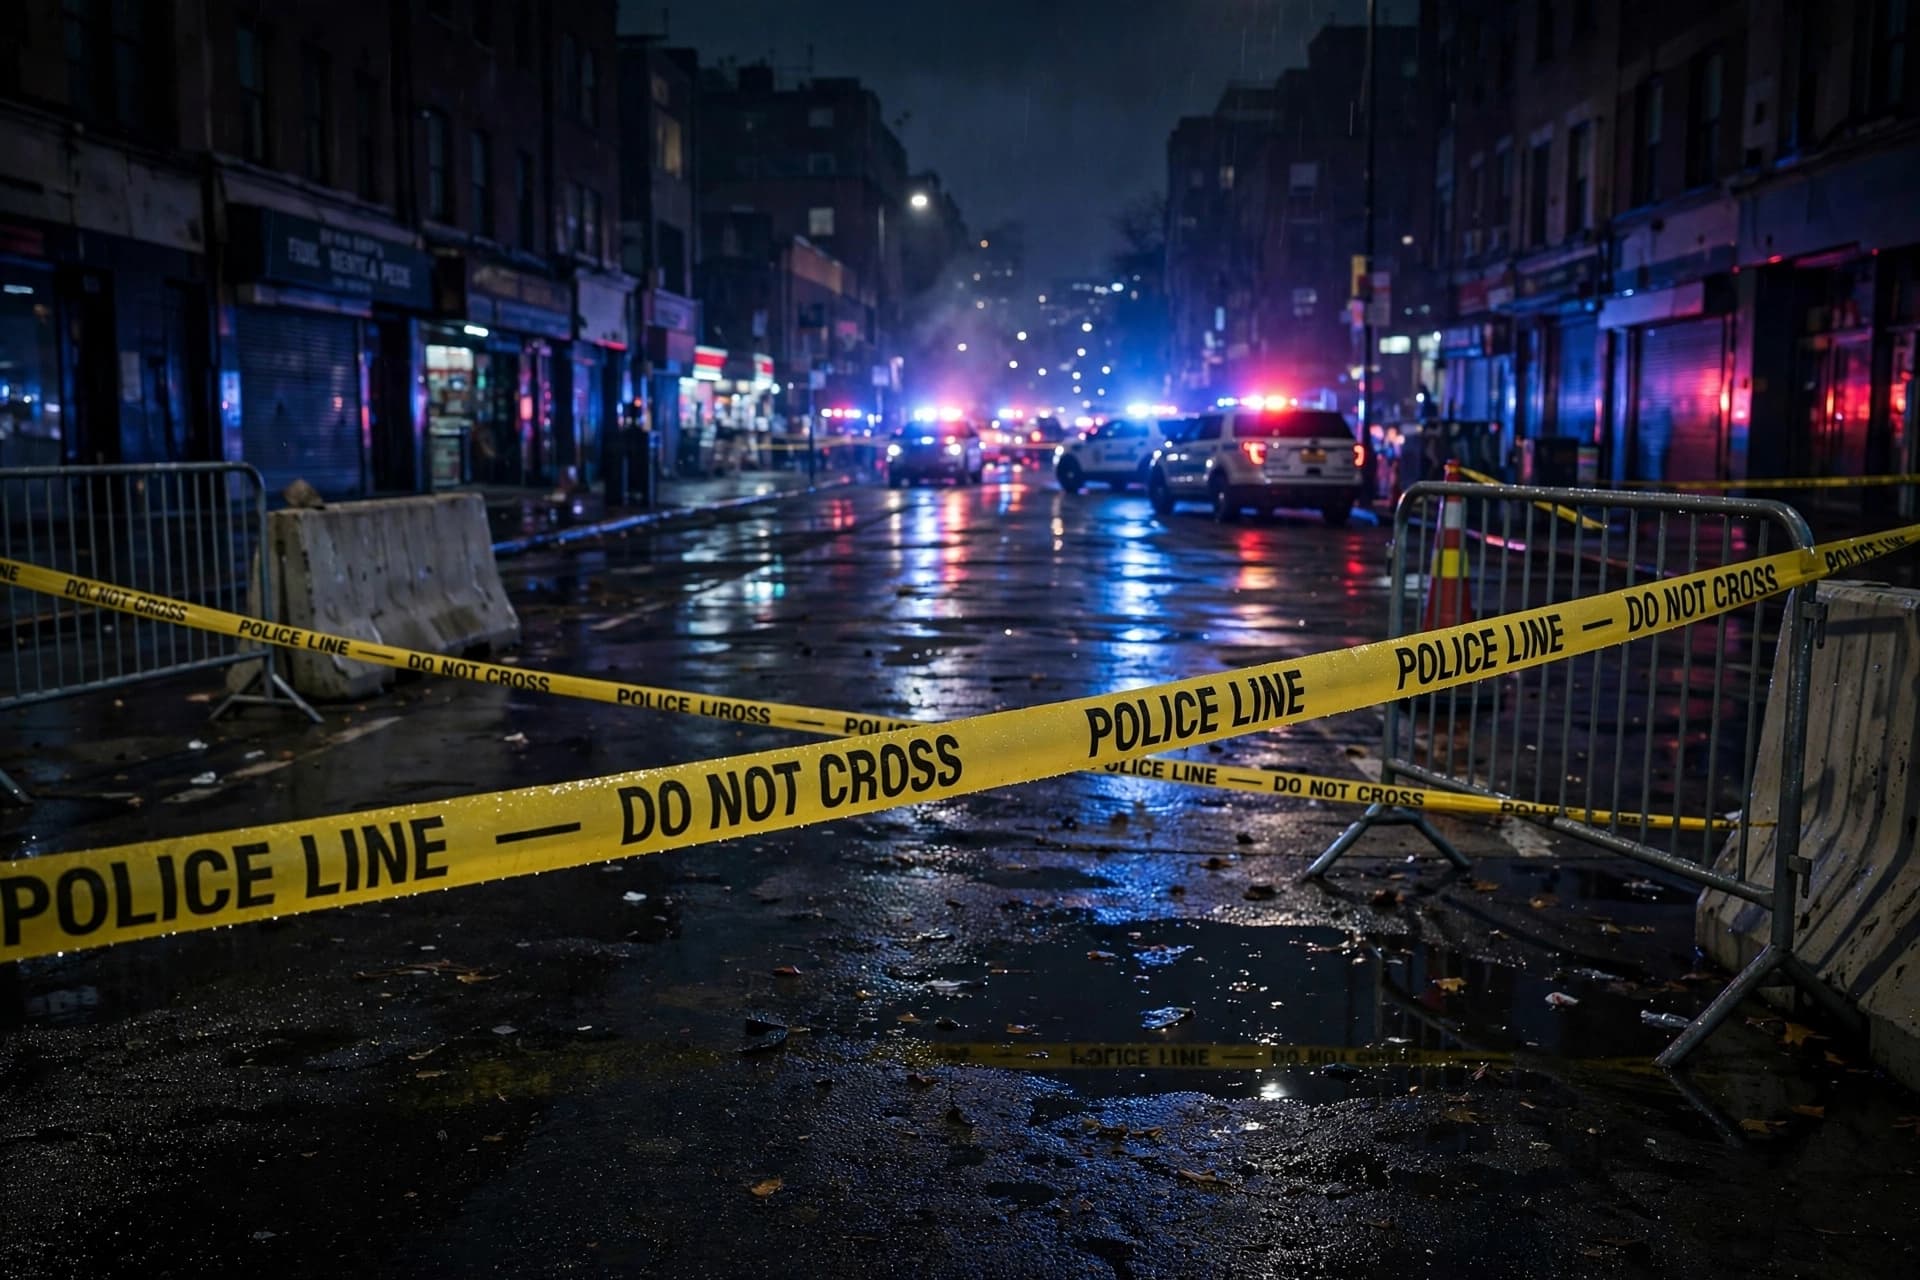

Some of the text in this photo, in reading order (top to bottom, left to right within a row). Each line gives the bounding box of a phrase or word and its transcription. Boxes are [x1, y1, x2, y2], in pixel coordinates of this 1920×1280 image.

[64, 579, 88, 598] DO
[96, 588, 131, 609] NOT
[134, 596, 188, 622] CROSS
[238, 619, 301, 646] POLICE
[307, 631, 350, 656] LINE
[408, 654, 434, 673] DO
[441, 661, 480, 680] NOT
[486, 668, 550, 693] CROSS
[617, 688, 690, 714] POLICE
[0, 841, 276, 947] POLICE
[300, 815, 449, 899] LINE
[617, 780, 692, 846] DO
[706, 761, 802, 830] NOT
[819, 734, 963, 808] CROSS
[1084, 686, 1219, 758] POLICE
[1228, 669, 1305, 728] LINE
[1395, 628, 1498, 690] POLICE
[1504, 614, 1564, 665] LINE
[1625, 590, 1659, 633] DO
[1664, 579, 1706, 623] NOT
[1713, 564, 1779, 608] CROSS
[1104, 758, 1164, 779] OLICE
[1172, 763, 1217, 785] LINE
[1273, 775, 1301, 793] DO
[1309, 780, 1350, 800] NOT
[1357, 785, 1424, 807] CROSS
